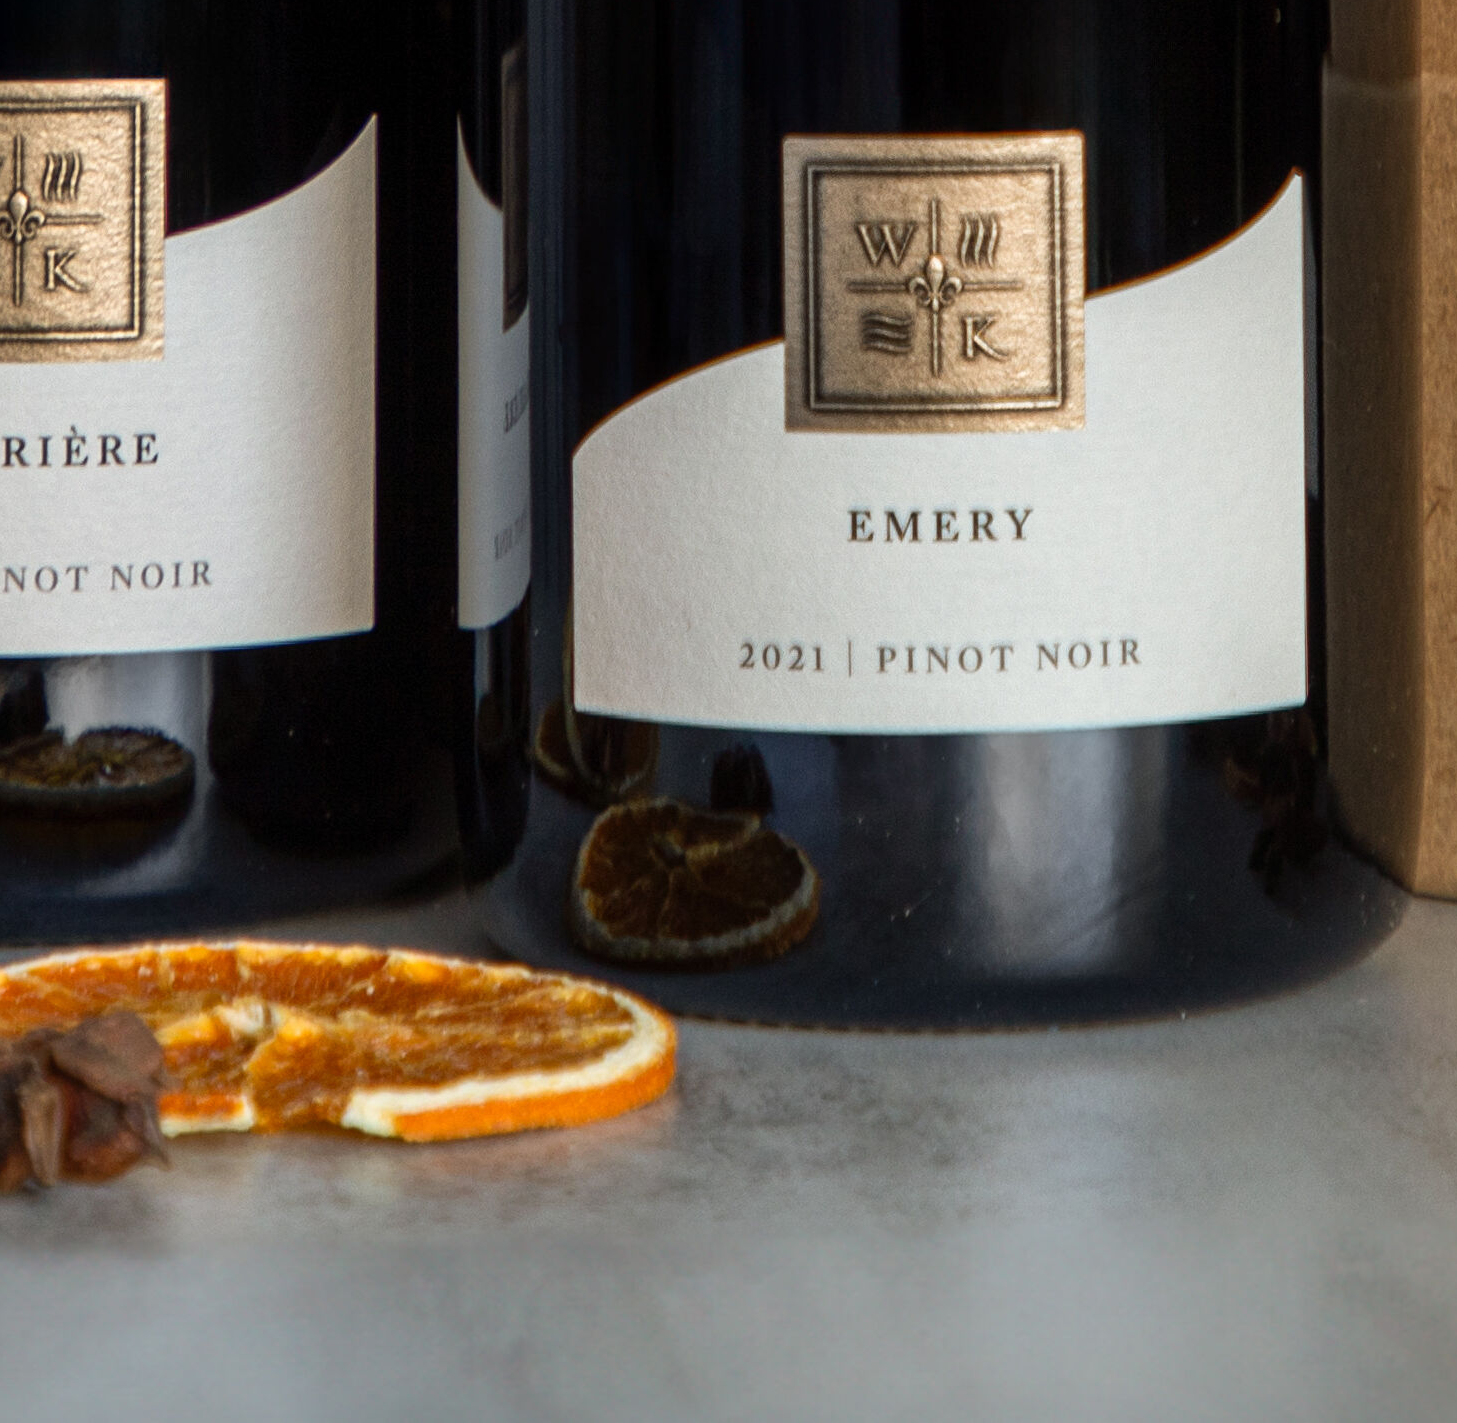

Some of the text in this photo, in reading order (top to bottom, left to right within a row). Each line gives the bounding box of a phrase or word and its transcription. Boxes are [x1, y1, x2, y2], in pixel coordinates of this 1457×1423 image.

[855, 222, 916, 268] W
[43, 246, 87, 294] K
[961, 314, 1011, 362] K
[847, 507, 1036, 545] EMERY
[109, 558, 216, 592] NOIR
[738, 639, 826, 674] 2021
[875, 643, 1016, 676] PINOT
[1035, 637, 1145, 673] NOIR
